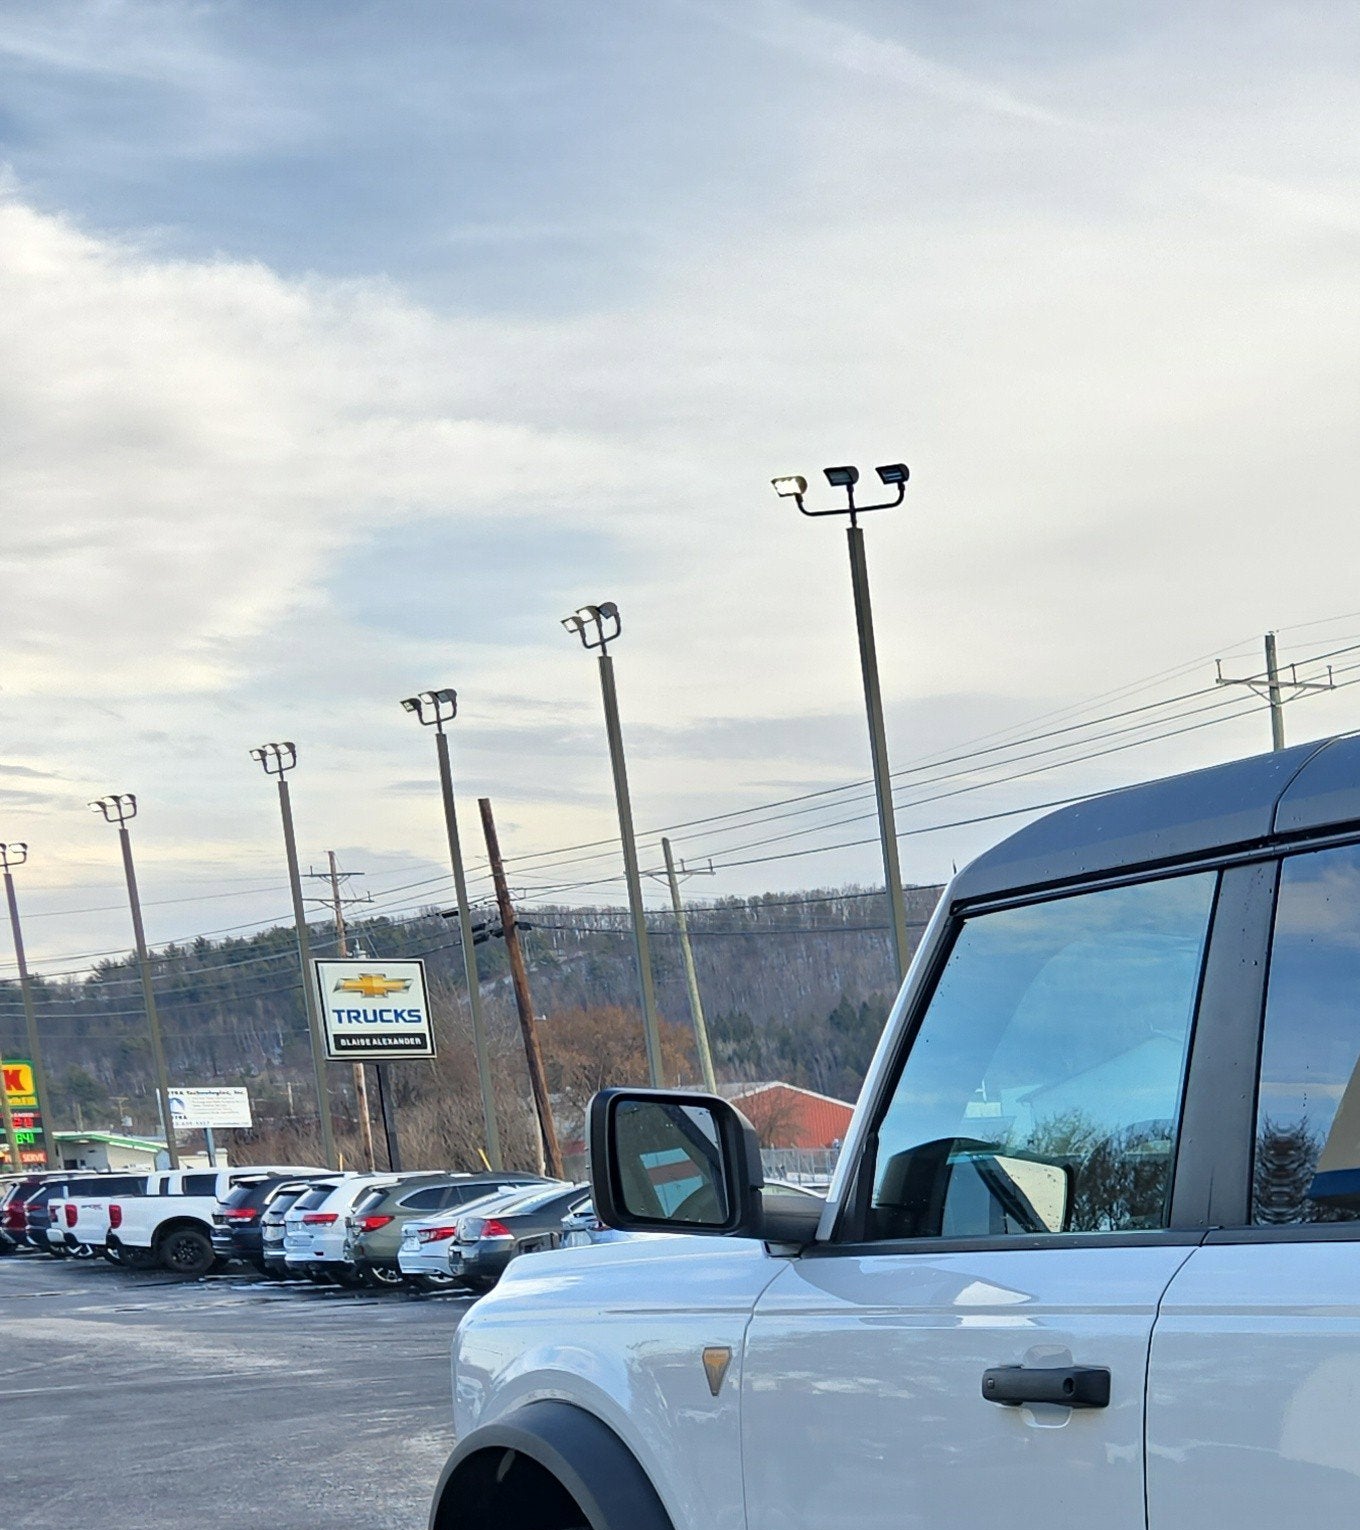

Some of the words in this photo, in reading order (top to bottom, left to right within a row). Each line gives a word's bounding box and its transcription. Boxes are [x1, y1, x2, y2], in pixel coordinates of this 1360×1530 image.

[332, 1008, 422, 1024] TRUCKS
[340, 1038, 371, 1046] BLAISE
[372, 1037, 422, 1046] ALEXANDER
